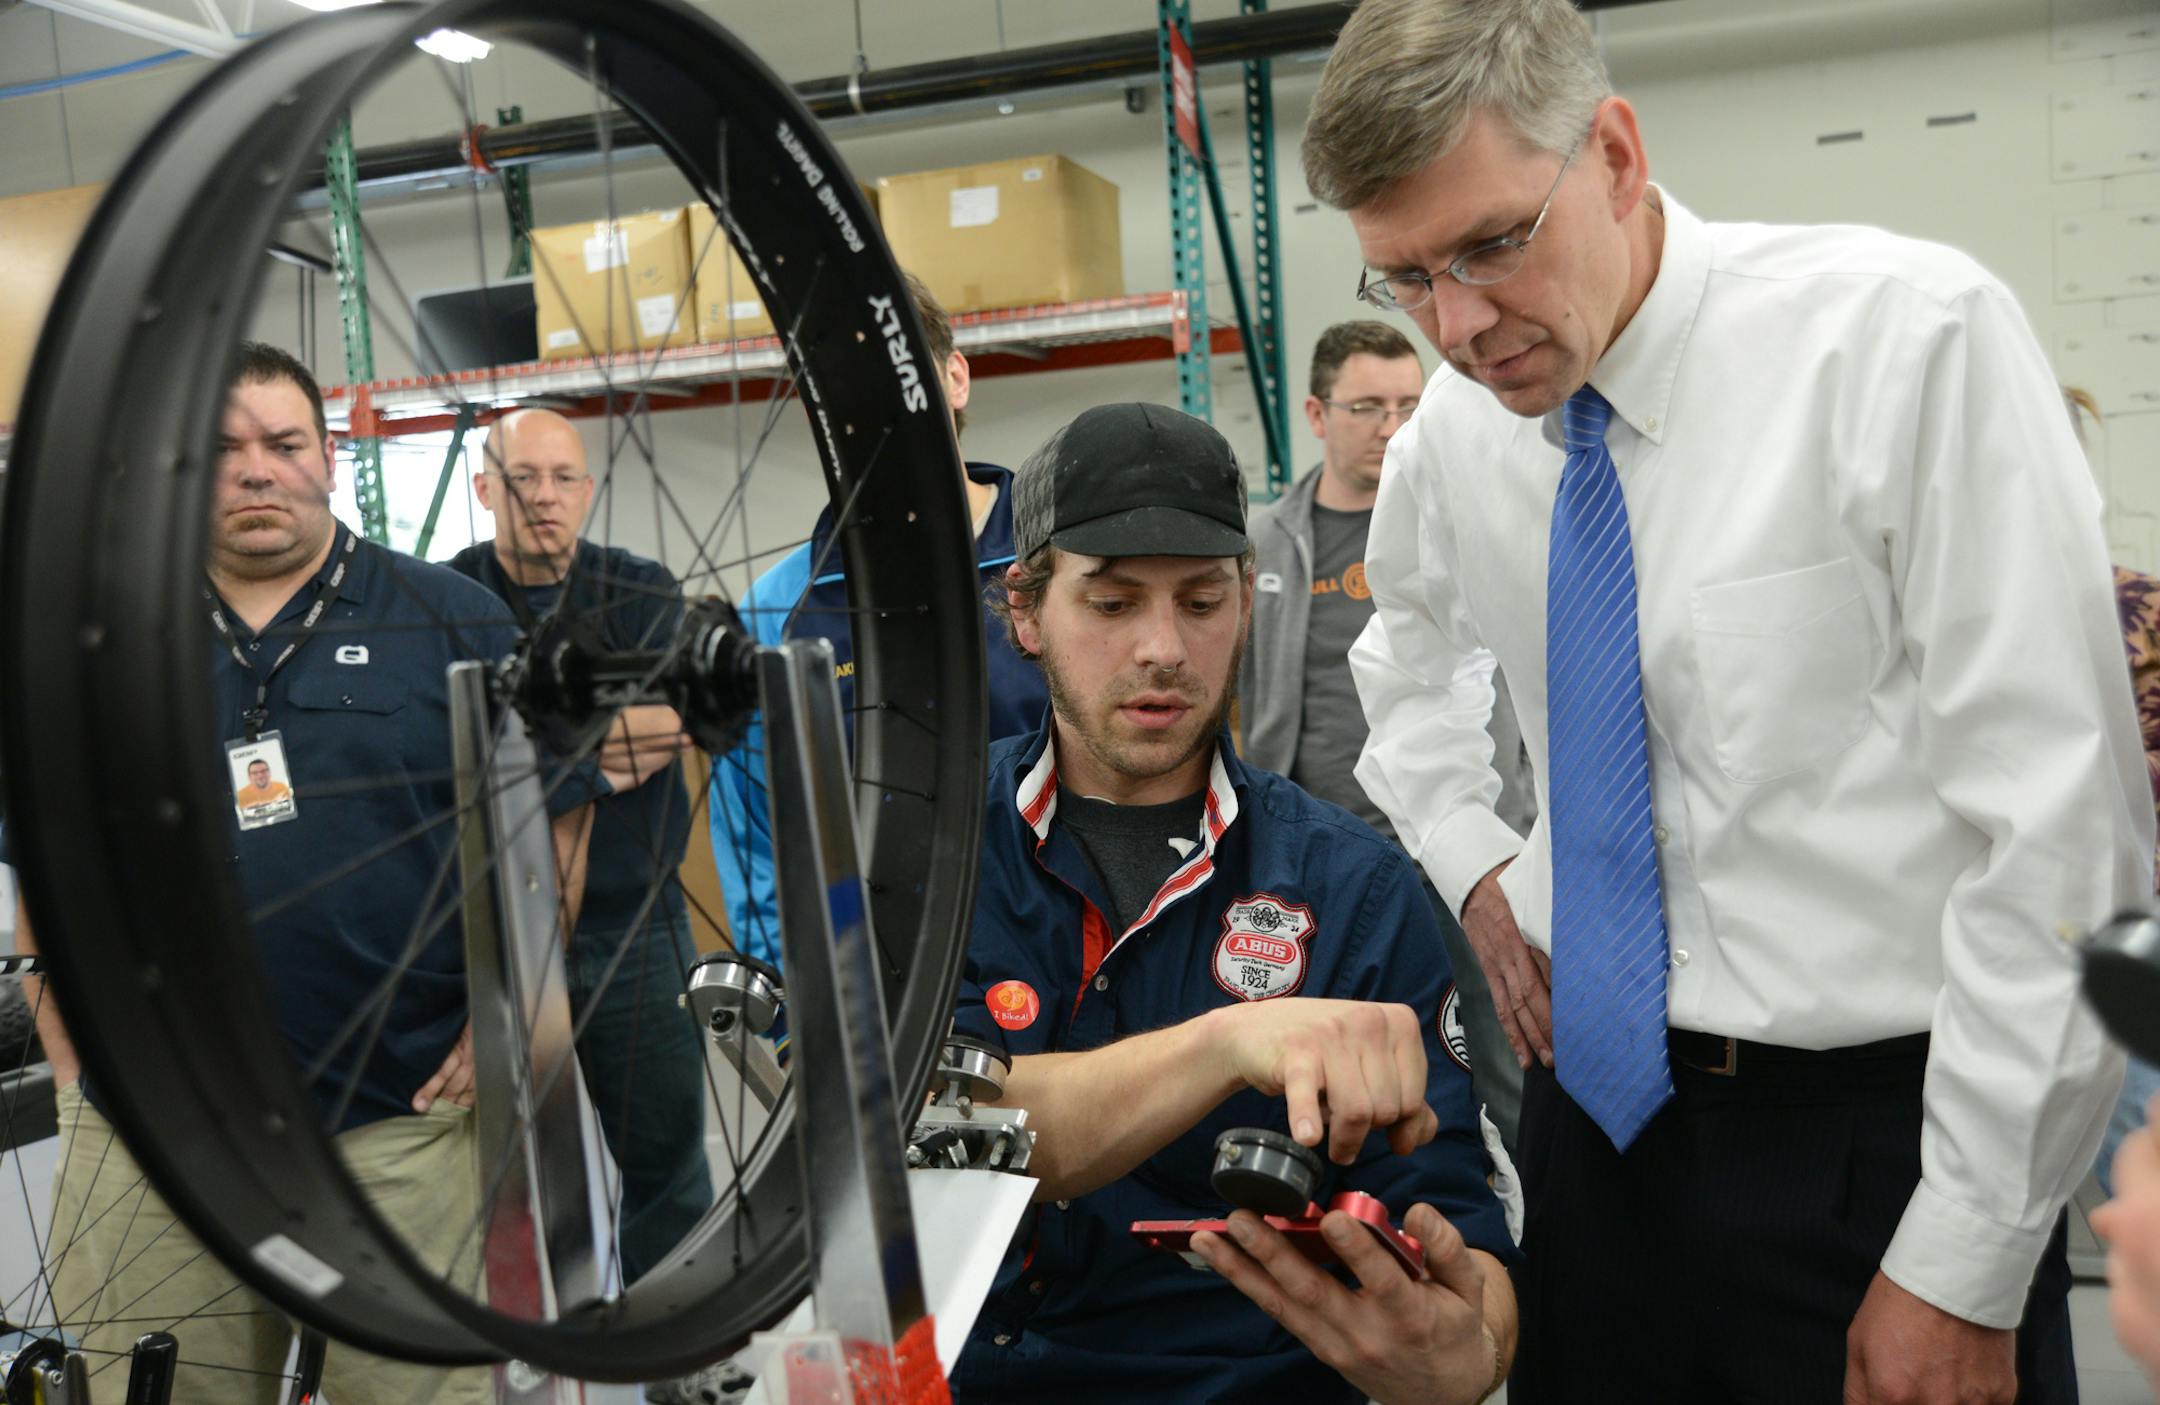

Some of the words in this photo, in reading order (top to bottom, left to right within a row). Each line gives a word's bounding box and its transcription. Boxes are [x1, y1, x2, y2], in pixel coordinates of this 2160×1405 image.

[777, 120, 824, 188] DARRYL
[817, 183, 866, 253] ROLLING
[867, 295, 928, 414] SURLY
[1235, 938, 1287, 958] ABUS
[1240, 965, 1271, 980] SINCE
[1241, 974, 1268, 990] 1924
[994, 1010, 999, 1018] I
